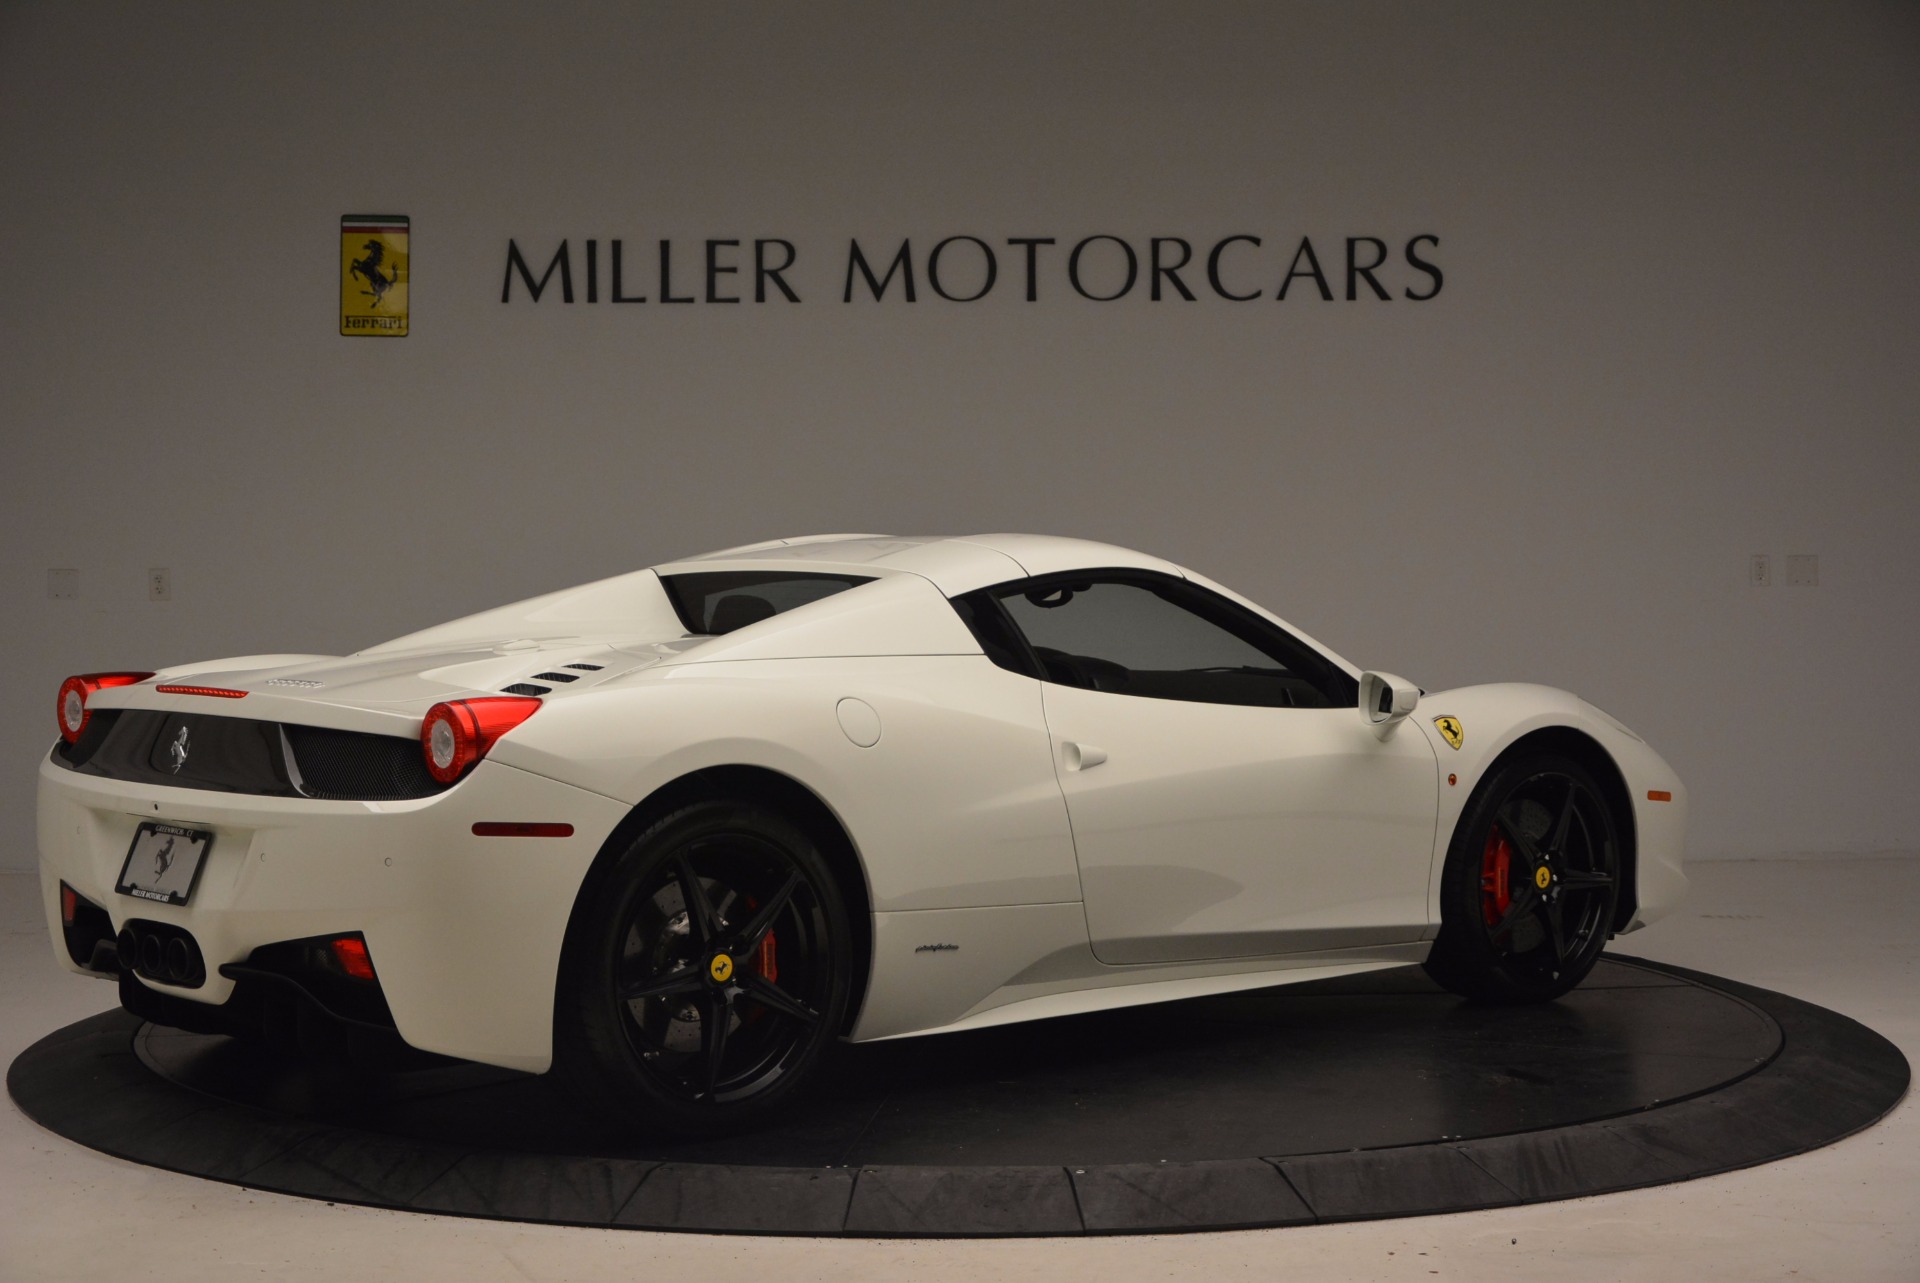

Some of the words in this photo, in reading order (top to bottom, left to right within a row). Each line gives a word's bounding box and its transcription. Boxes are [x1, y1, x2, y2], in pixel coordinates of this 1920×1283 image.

[501, 238, 802, 303] MILLER
[843, 234, 1444, 303] MOTORCARS
[344, 315, 403, 329] Ferrari
